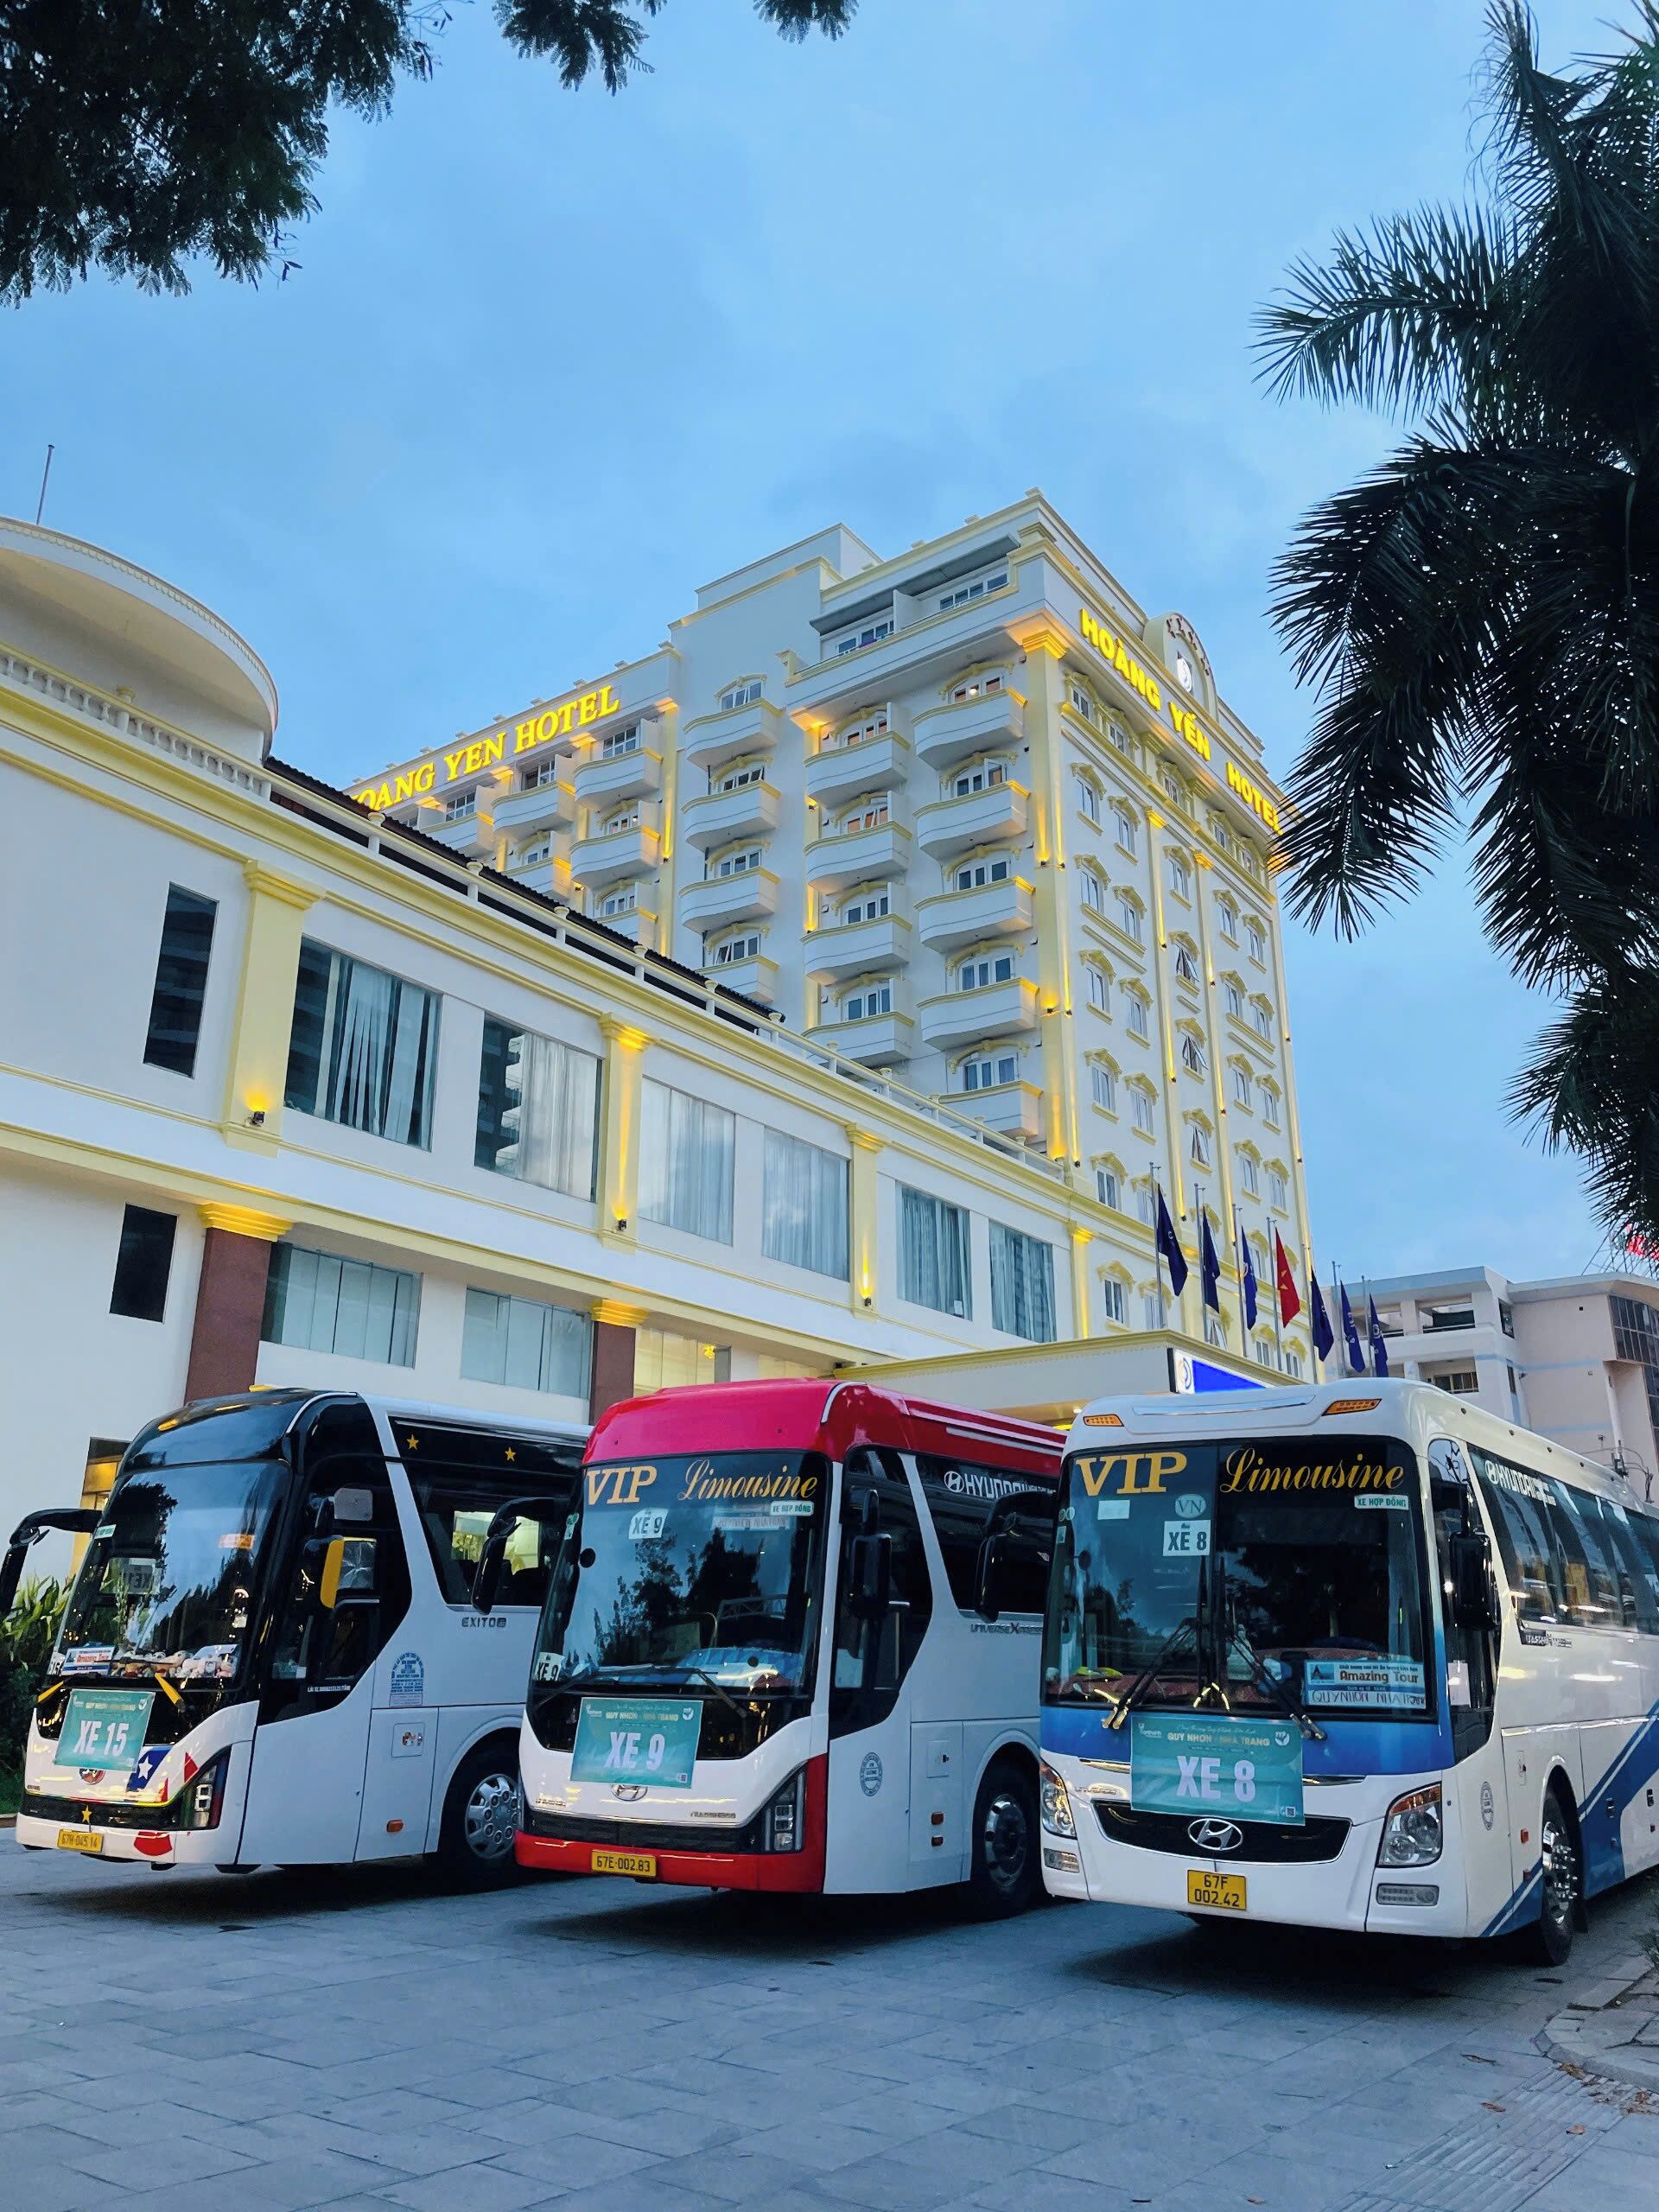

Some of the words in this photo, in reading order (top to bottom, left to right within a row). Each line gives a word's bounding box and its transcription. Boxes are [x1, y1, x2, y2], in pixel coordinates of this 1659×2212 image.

[1080, 607, 1161, 711] HOÀNG
[351, 762, 435, 812] OANG
[443, 732, 506, 781] YEN
[513, 685, 621, 753] HOTEL
[1076, 1452, 1187, 1497] VIP
[1219, 1447, 1404, 1493] Limousine
[587, 1465, 657, 1505] VIP
[677, 1459, 817, 1501] Limousine
[1178, 1499, 1202, 1513] VN
[1357, 1497, 1366, 1506] XE
[632, 1517, 650, 1535] XE
[654, 1517, 663, 1534] 9
[1168, 1531, 1191, 1551] XE
[1196, 1531, 1207, 1551] 8
[461, 1617, 495, 1628] EXITO
[1340, 1670, 1389, 1683] Amazing
[1394, 1671, 1419, 1683] Tour
[73, 1719, 102, 1756] XE
[104, 1722, 130, 1757] 15
[1167, 1732, 1185, 1741] QUY
[604, 1732, 641, 1770] XE
[646, 1733, 665, 1770] 9
[1176, 1755, 1221, 1799] XE
[1234, 1759, 1255, 1802] 8
[596, 1855, 650, 1872] 67E-002.83
[1204, 1874, 1228, 1889] 67F
[1194, 1889, 1240, 1907] 002.42
